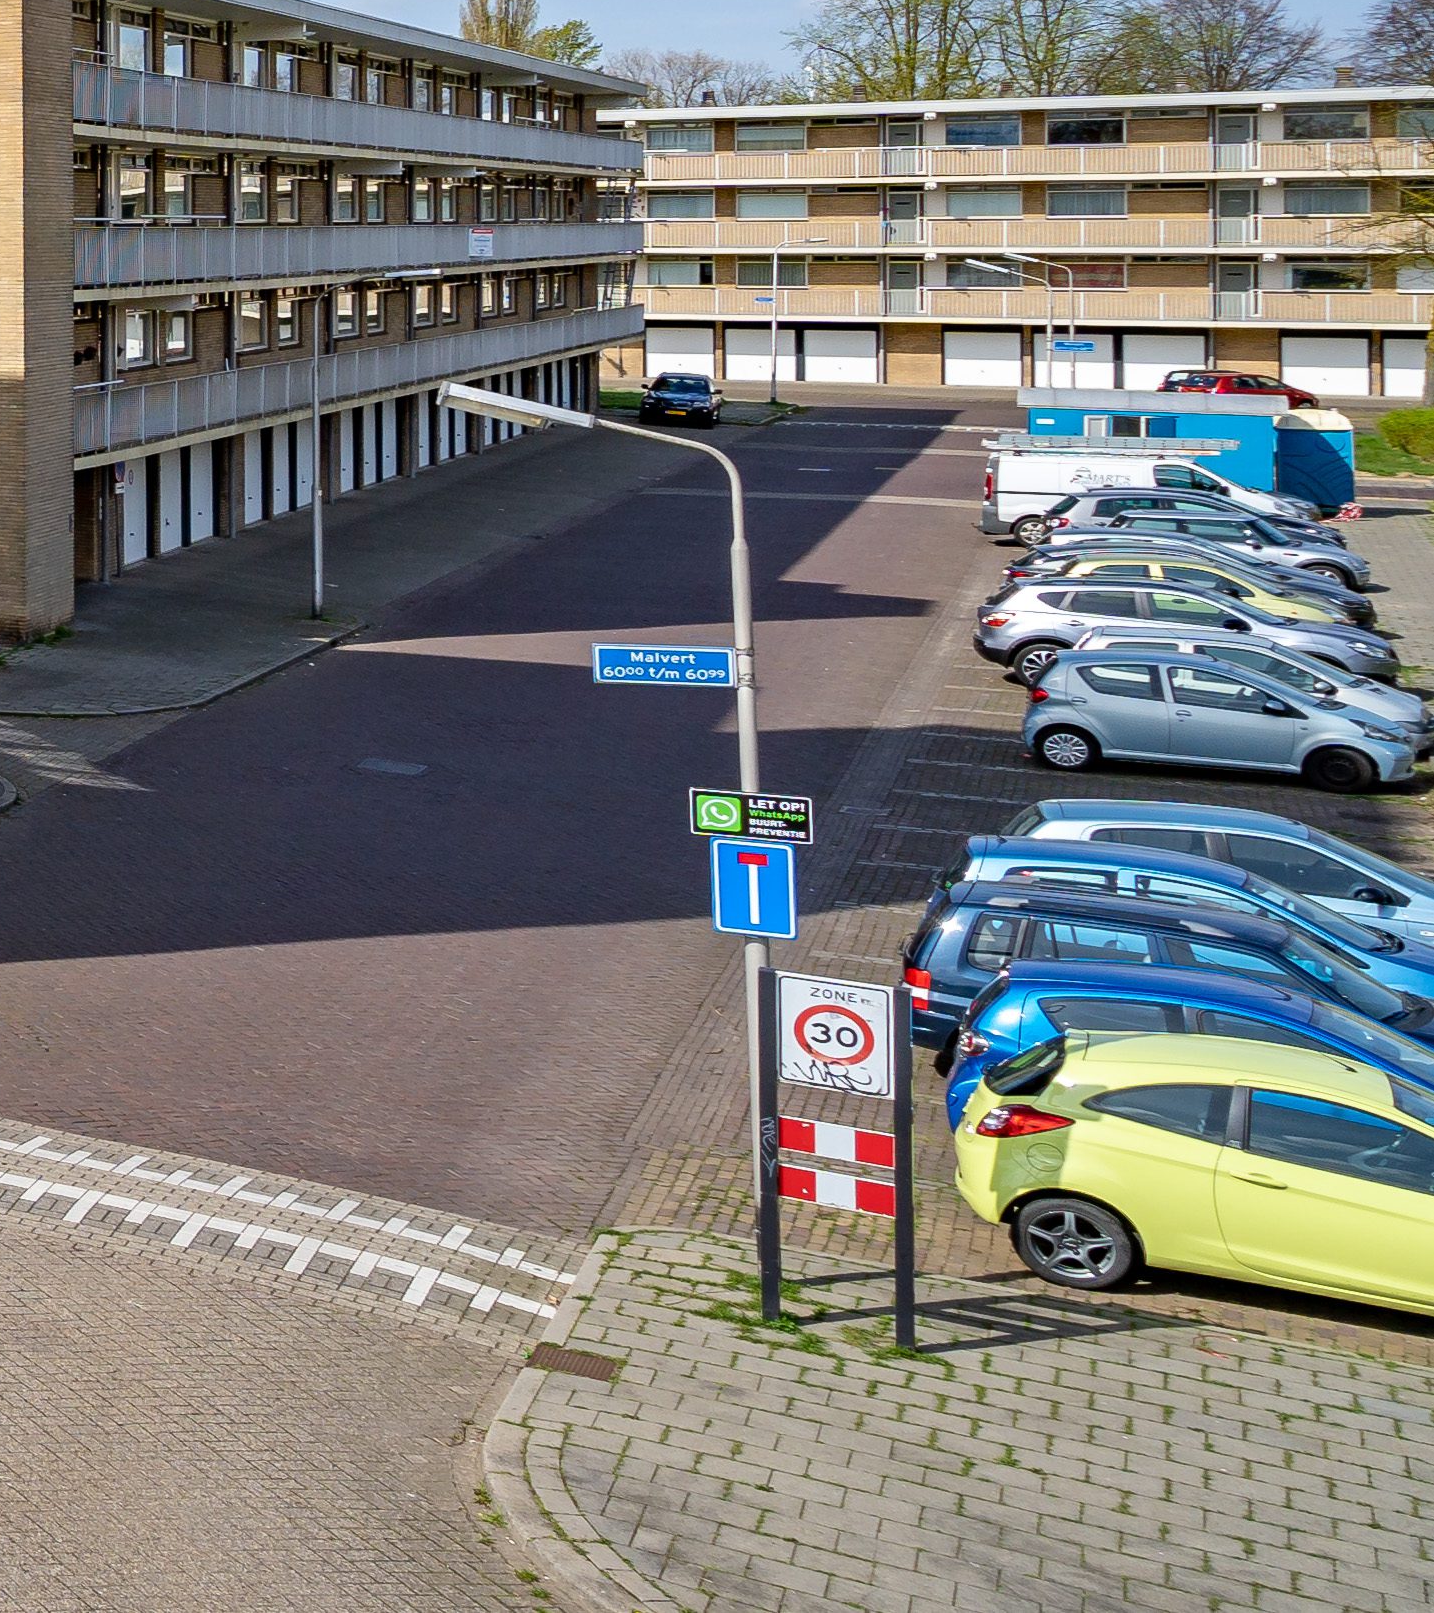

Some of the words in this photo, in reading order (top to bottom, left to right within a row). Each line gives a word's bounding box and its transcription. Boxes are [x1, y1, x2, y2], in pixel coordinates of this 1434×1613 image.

[630, 651, 697, 665] Malvert
[648, 667, 680, 679] t/m
[748, 798, 777, 810] LET
[779, 801, 806, 813] OP!
[748, 809, 806, 822] WhatsApp
[749, 827, 806, 839] PREVENTIE
[810, 986, 858, 1003] ZONE
[810, 1022, 858, 1048] 30
